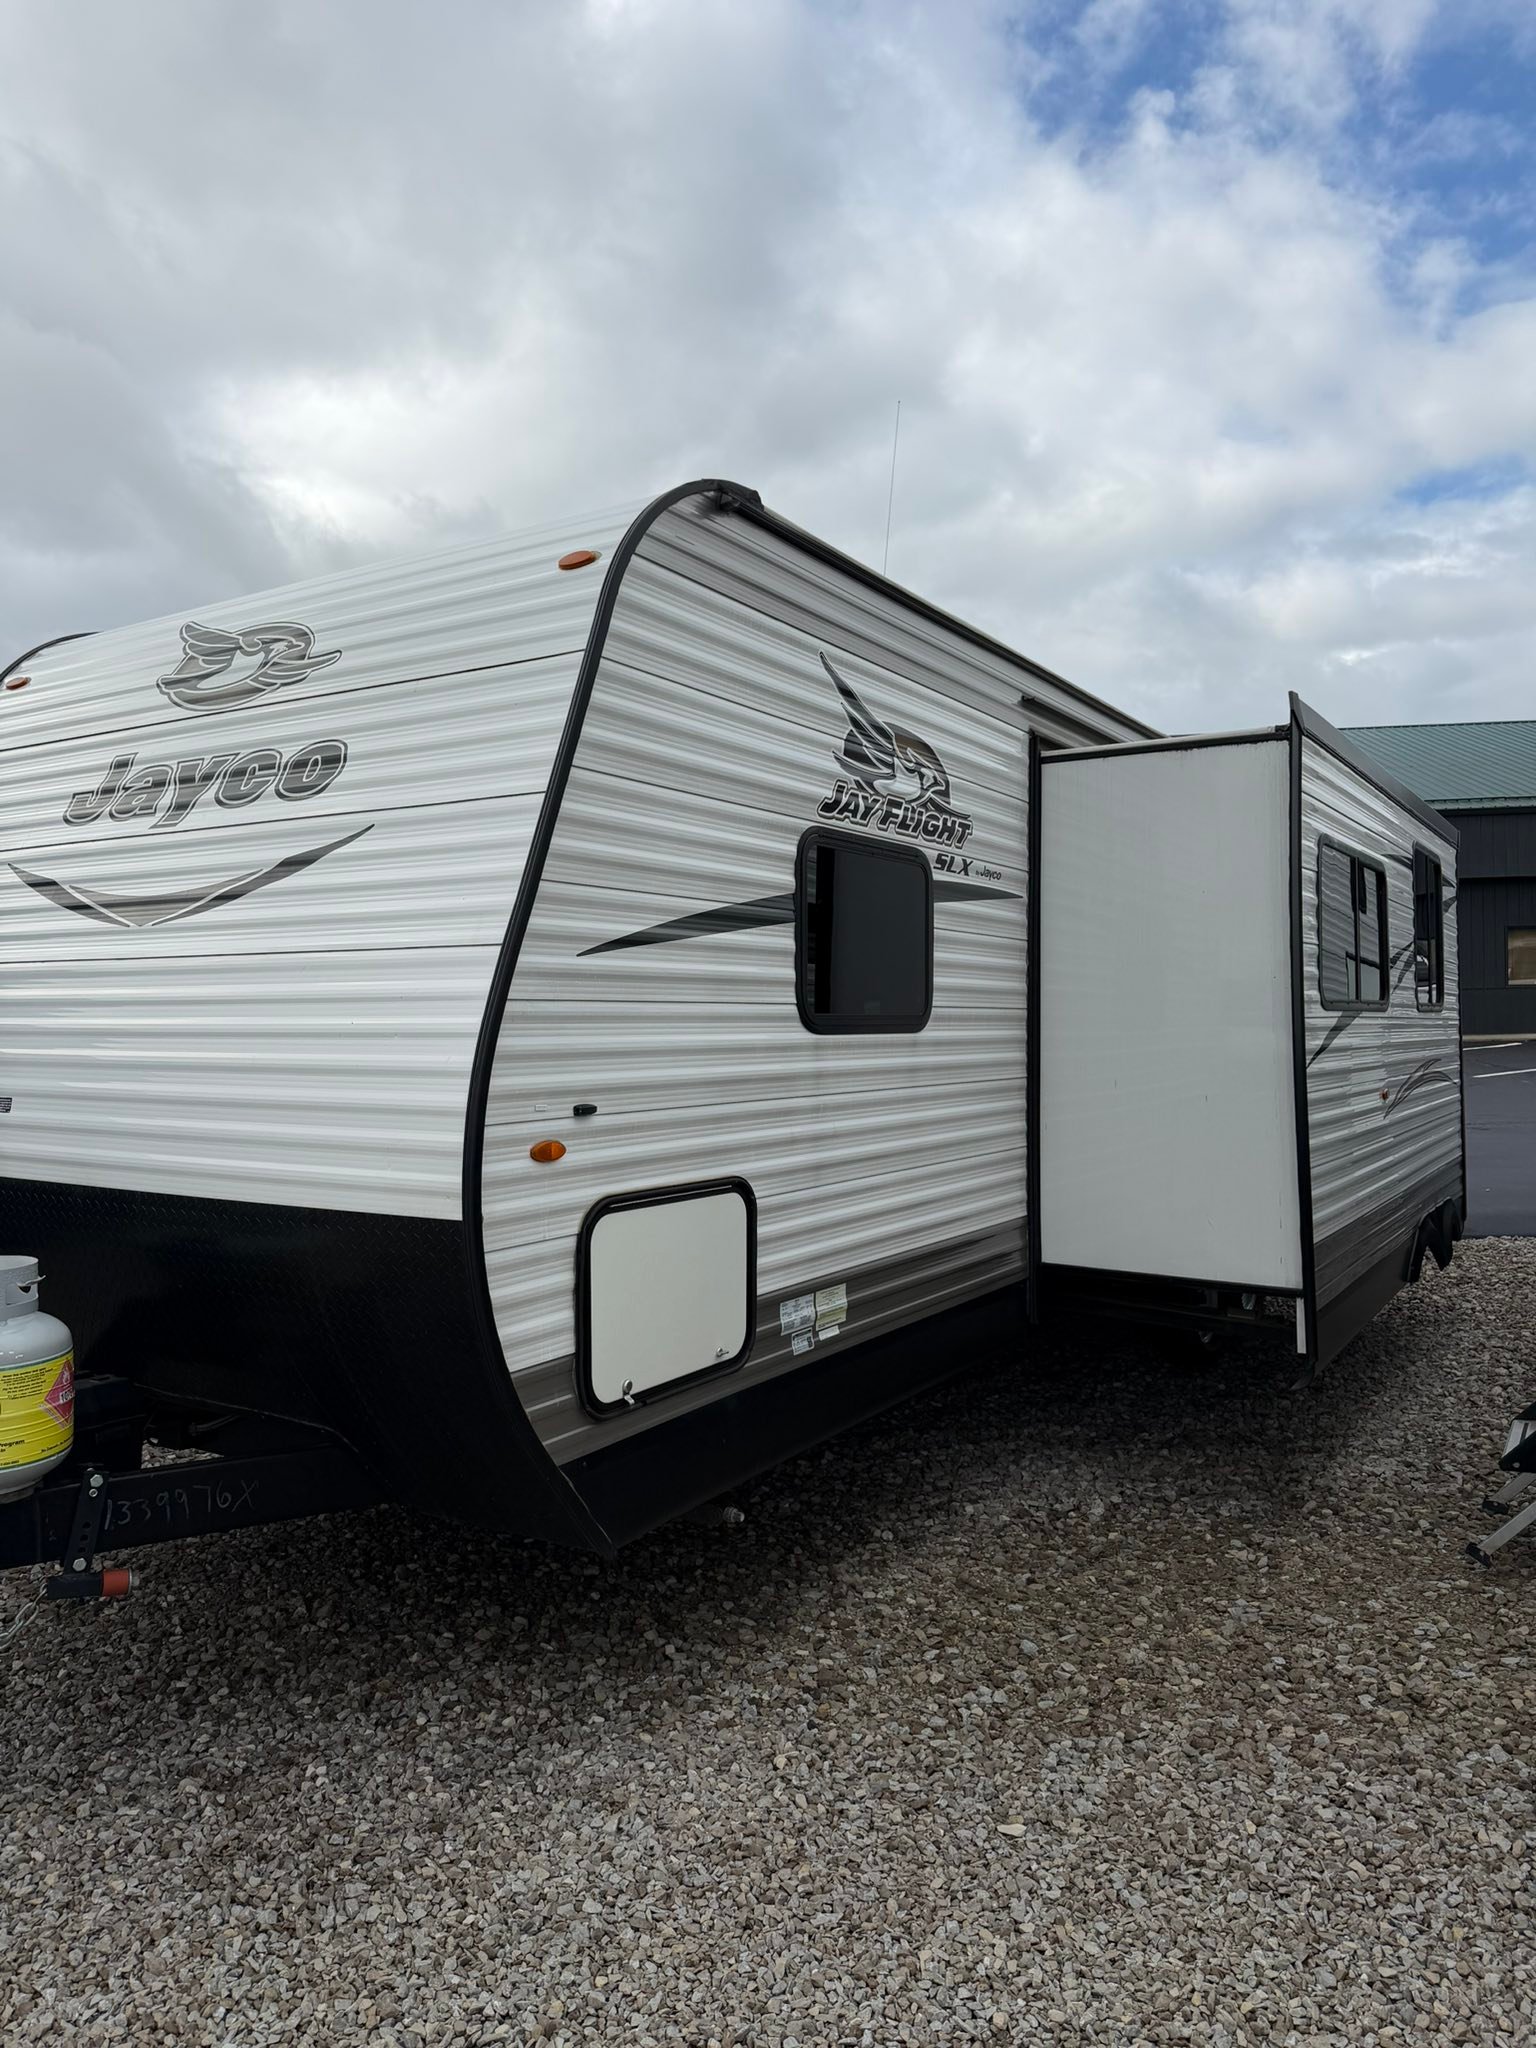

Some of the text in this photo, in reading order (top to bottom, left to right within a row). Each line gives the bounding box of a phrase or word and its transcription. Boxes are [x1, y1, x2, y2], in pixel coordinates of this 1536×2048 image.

[62, 738, 348, 829] Jayco
[816, 779, 974, 849] JAY FLIGHT
[933, 852, 974, 877] SLX
[980, 865, 1002, 881] Jayco
